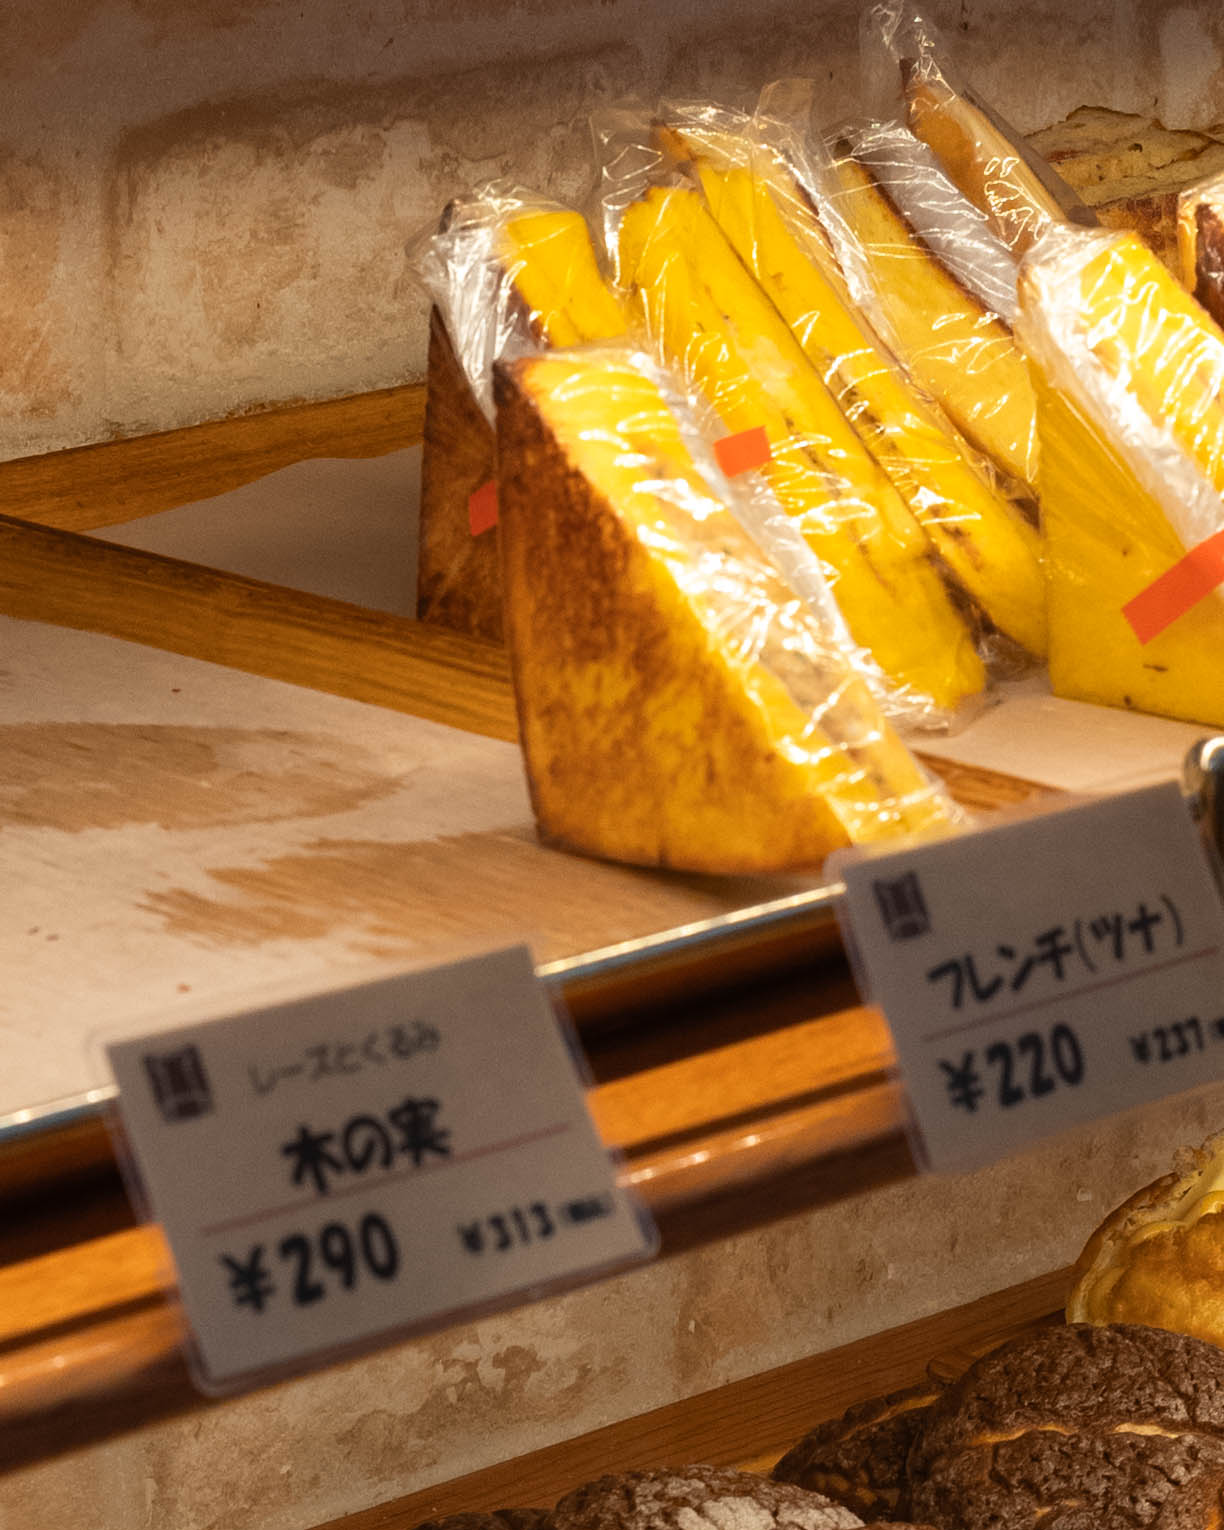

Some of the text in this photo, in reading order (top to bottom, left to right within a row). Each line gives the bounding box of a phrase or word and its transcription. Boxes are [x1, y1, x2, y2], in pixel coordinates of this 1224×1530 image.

[926, 894, 1185, 1008] フレンチ(ツナ)
[938, 1023, 1084, 1112] ¥220
[1128, 1017, 1205, 1064] ¥237
[281, 1097, 451, 1195] 木の実
[218, 1211, 399, 1313] ¥290
[456, 1203, 556, 1256] ¥313
